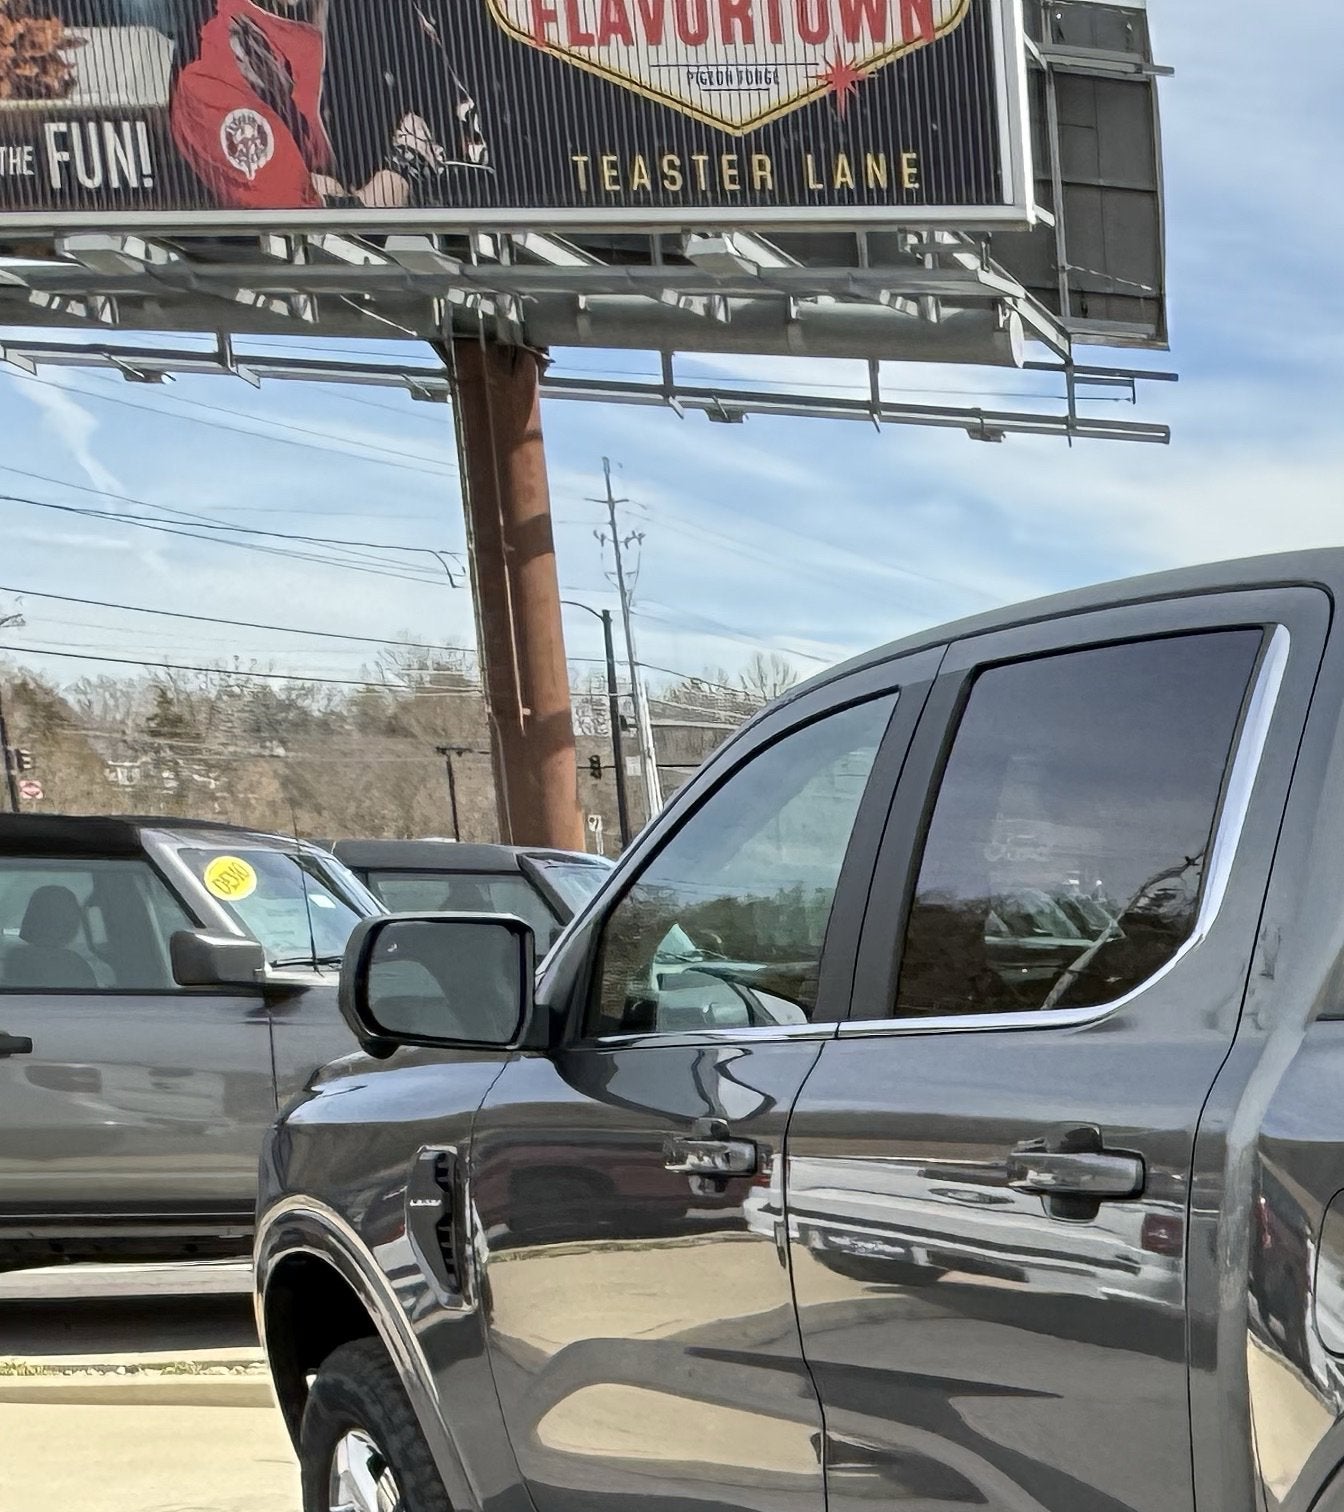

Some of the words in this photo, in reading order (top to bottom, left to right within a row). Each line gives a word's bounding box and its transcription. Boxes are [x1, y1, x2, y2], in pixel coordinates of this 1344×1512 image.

[44, 121, 153, 188] FUN!
[572, 153, 774, 191] TEASTER
[806, 152, 919, 190] LANE
